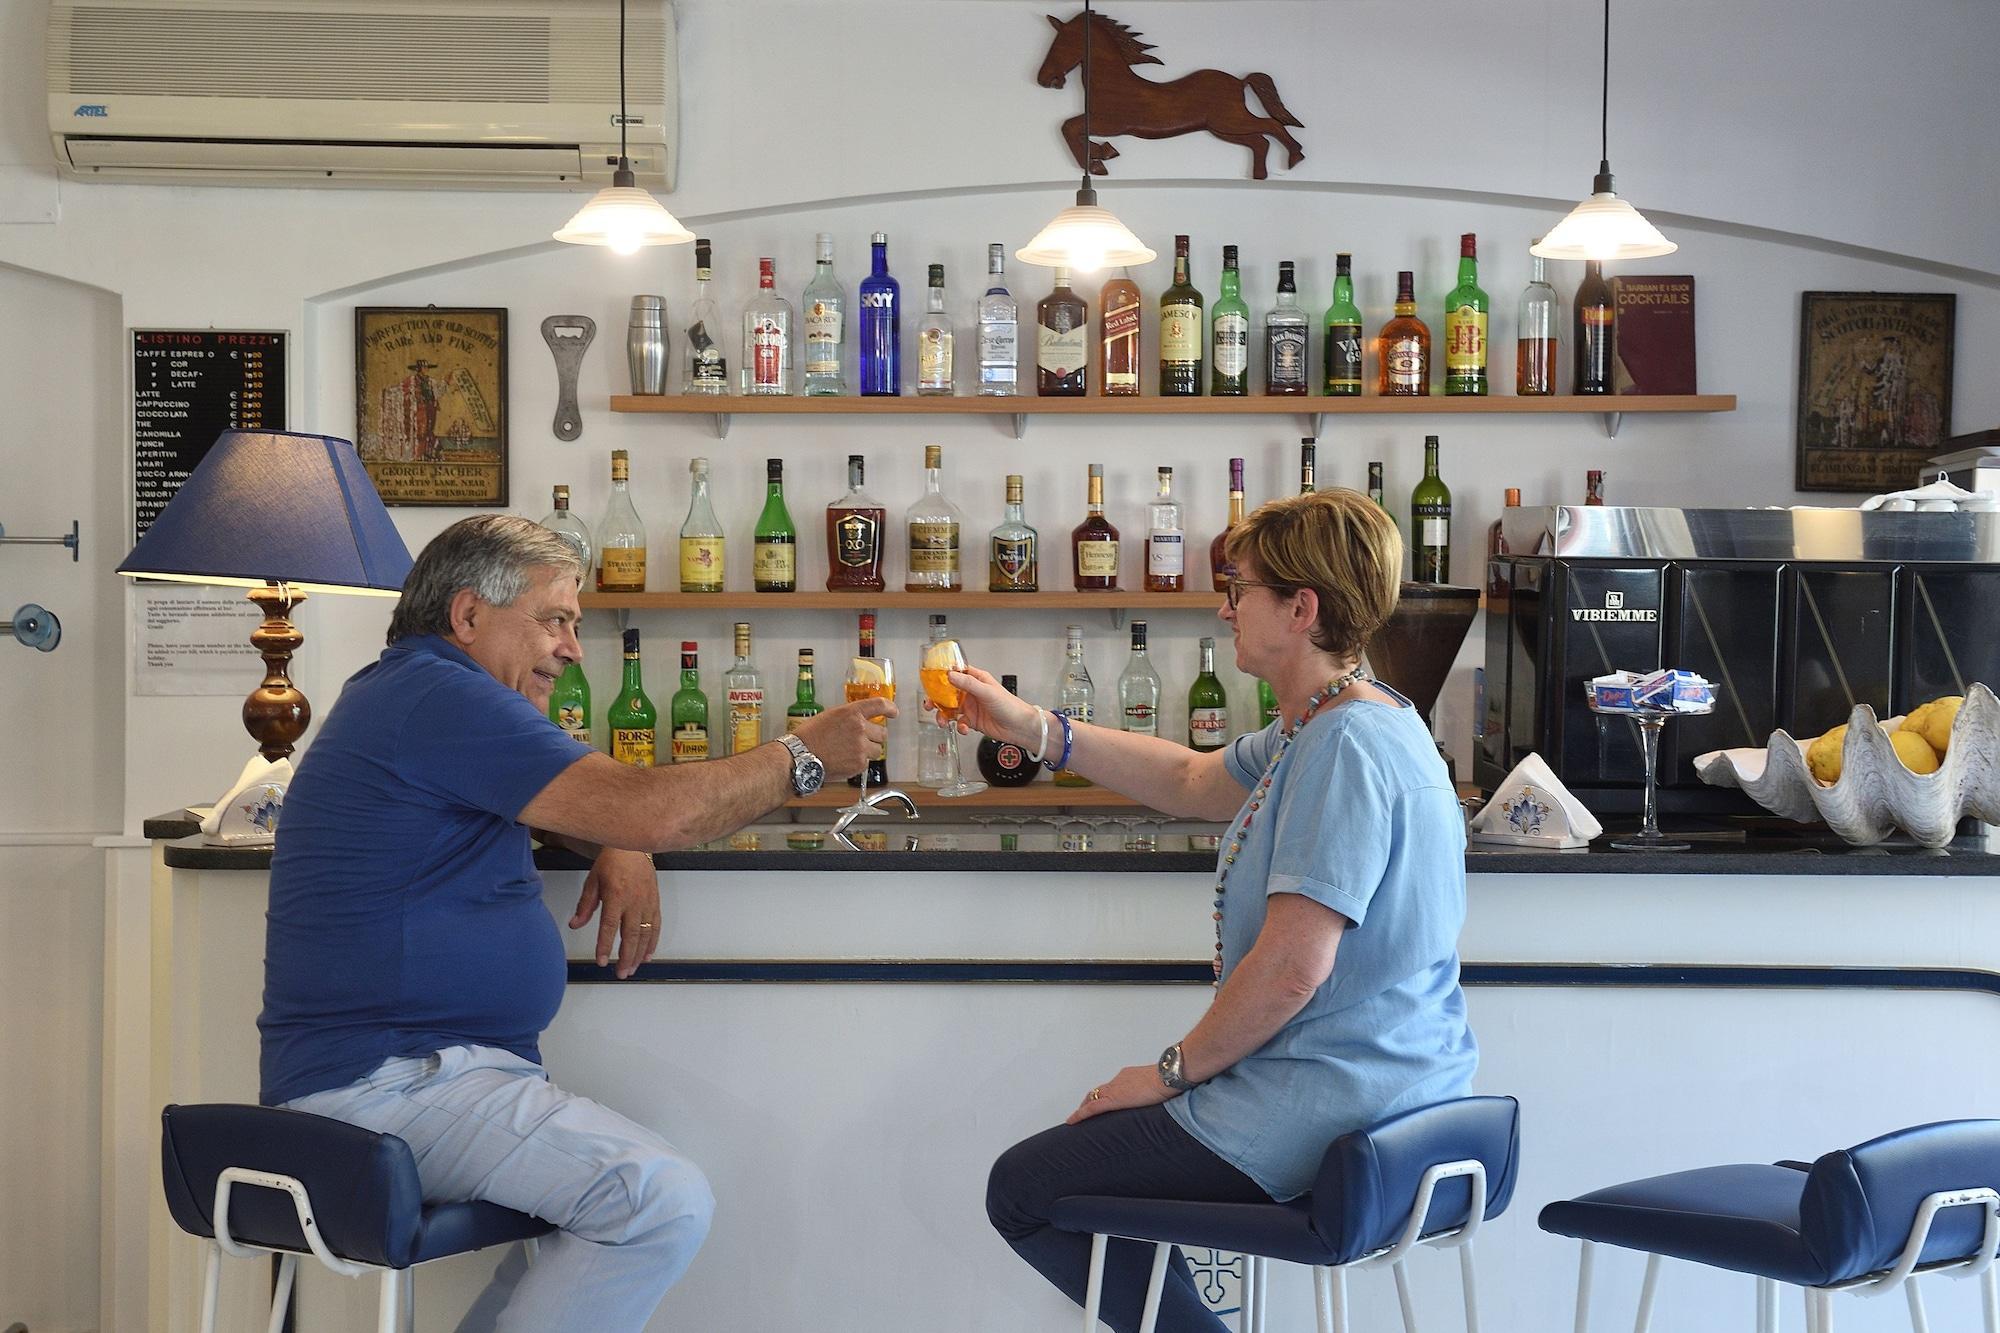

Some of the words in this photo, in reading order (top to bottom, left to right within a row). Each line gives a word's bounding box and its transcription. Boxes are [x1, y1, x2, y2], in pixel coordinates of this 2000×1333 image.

[74, 104, 108, 117] ARTEL
[861, 292, 894, 308] SKYY
[1618, 293, 1690, 305] COCKTAILS
[1160, 310, 1197, 322] JAMESON
[1106, 320, 1119, 330] Red
[1119, 314, 1137, 326] Label
[141, 335, 202, 345] LISTINO
[217, 335, 273, 345] PREZZI
[136, 390, 161, 398] LATTE
[136, 400, 190, 409] CAPPUCCINO
[136, 450, 177, 458] APERITIVI
[382, 466, 427, 477] GEORGE
[1571, 609, 1657, 622] VIBIEMME
[729, 691, 763, 701] AVERNA
[1192, 720, 1226, 729] PERNO
